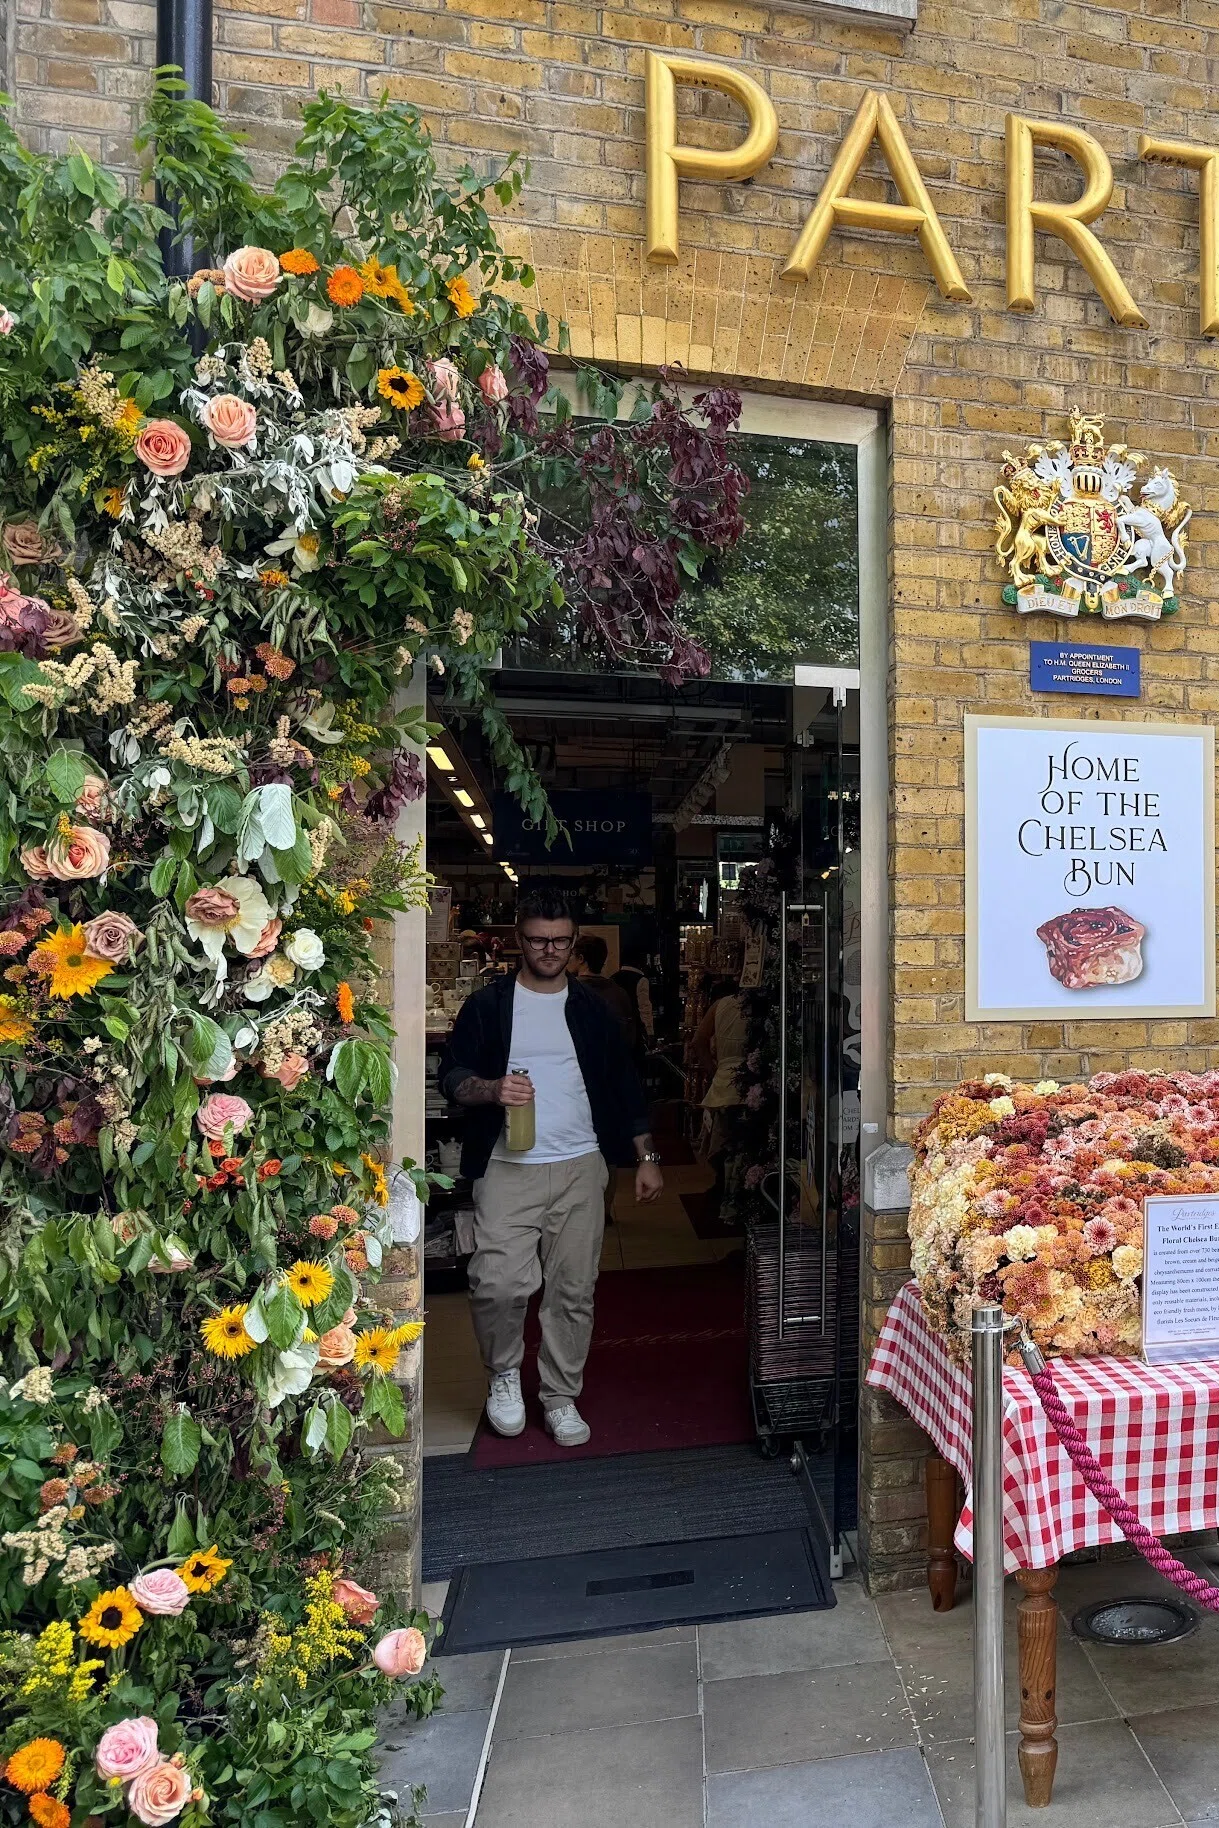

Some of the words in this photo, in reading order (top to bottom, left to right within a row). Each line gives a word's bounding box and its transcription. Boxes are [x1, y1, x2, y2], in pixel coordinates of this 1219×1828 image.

[1027, 598, 1054, 608] DIEU
[1058, 600, 1076, 612] ET
[1106, 604, 1128, 615] MON
[1130, 602, 1162, 616] DROIT
[1070, 653, 1114, 662] APPOINTMENT
[1092, 662, 1125, 670] ELIZABETH
[1053, 674, 1095, 684] PARTRIDGES,
[1038, 741, 1140, 794] HOME
[1042, 790, 1083, 814] OF
[1096, 792, 1160, 817] THE
[574, 820, 626, 832] SHOP
[1018, 819, 1168, 856] CHELSEA
[1064, 858, 1134, 896] BUN
